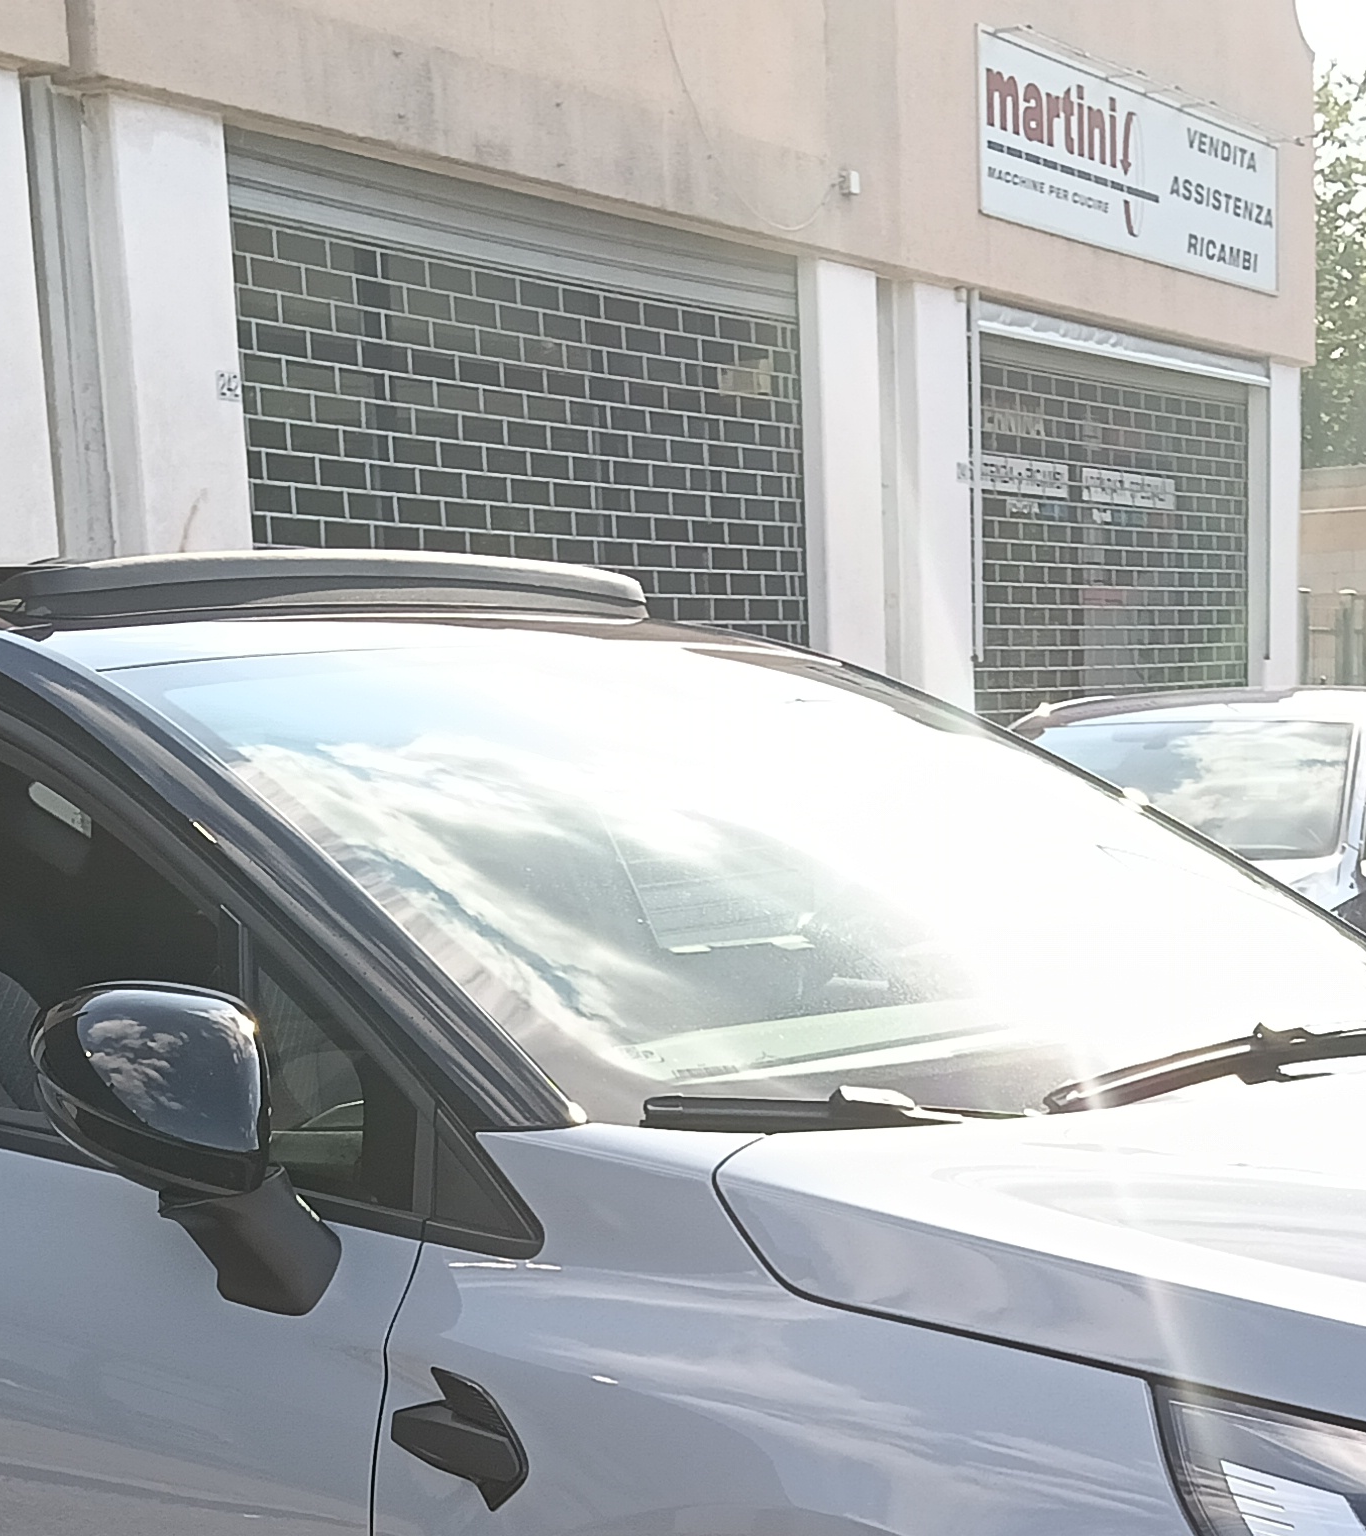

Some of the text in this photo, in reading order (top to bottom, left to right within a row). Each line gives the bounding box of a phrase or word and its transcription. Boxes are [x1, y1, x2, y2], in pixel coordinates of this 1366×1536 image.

[1187, 128, 1257, 172] VENDITA
[1049, 185, 1068, 200] PER
[1170, 176, 1272, 228] ASSISTENZA
[1187, 234, 1258, 272] RICAMBI
